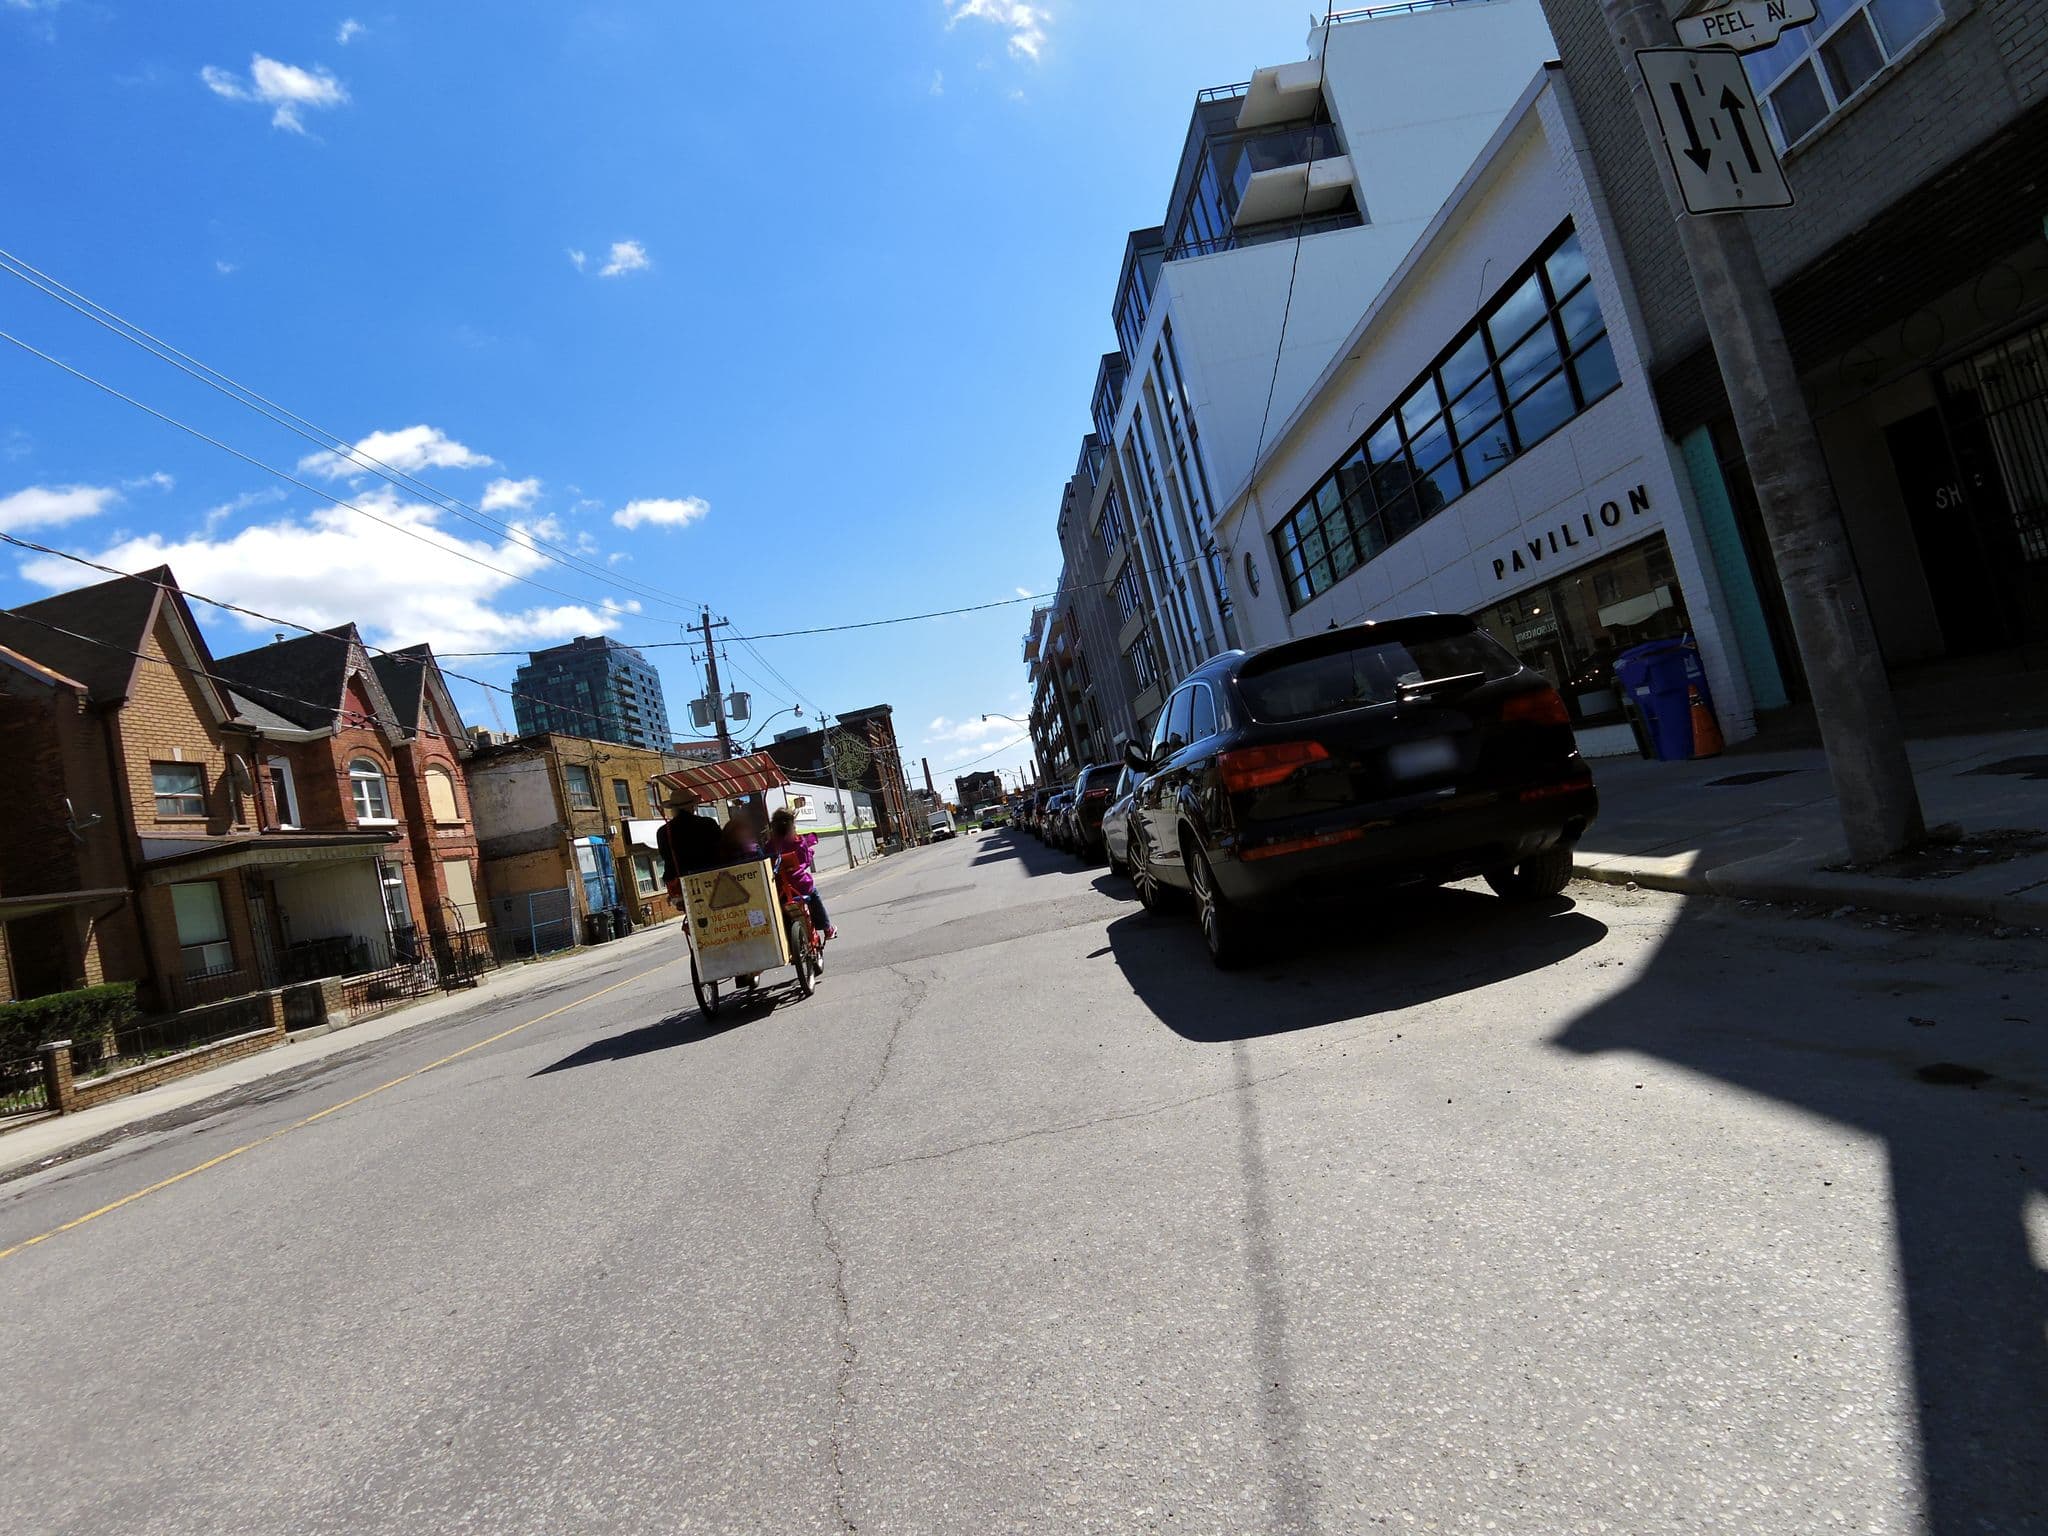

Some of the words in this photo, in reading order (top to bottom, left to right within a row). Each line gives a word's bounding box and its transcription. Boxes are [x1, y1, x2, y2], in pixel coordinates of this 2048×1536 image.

[1702, 11, 1755, 38] PEEL
[1766, 0, 1792, 23] AV.
[1492, 485, 1650, 580] PAVILION
